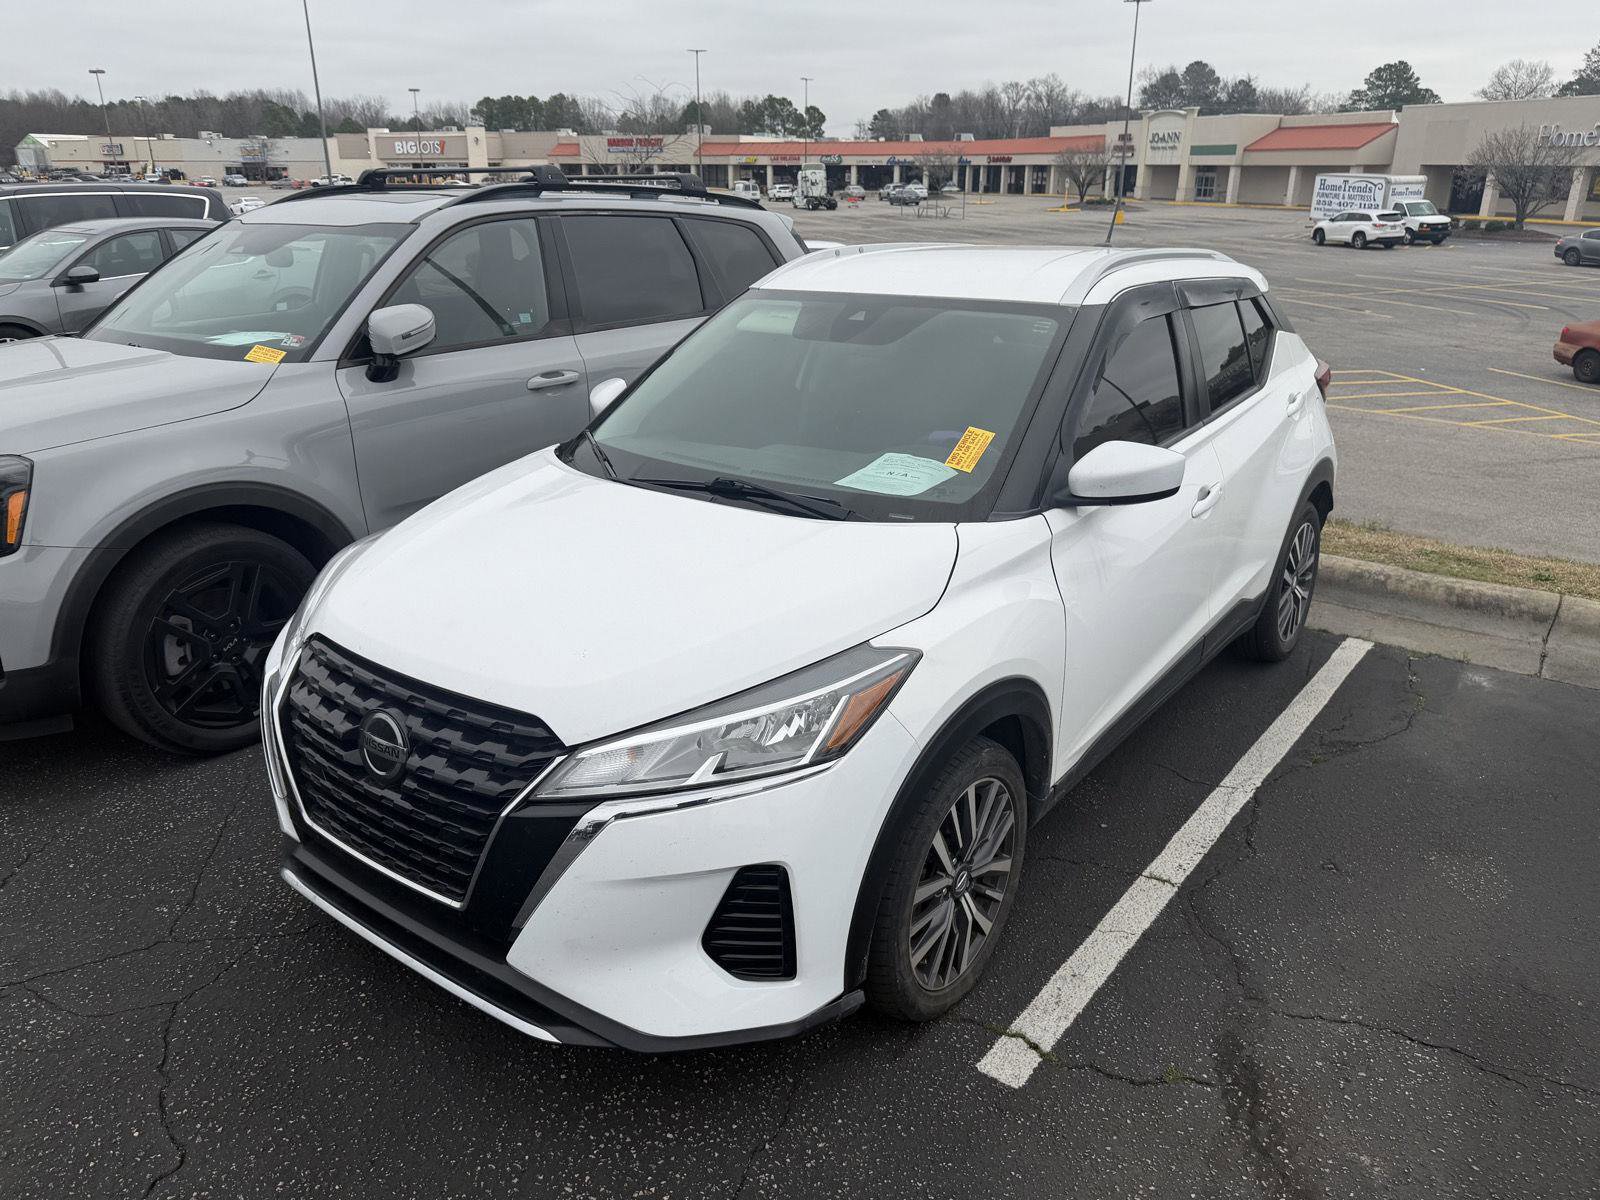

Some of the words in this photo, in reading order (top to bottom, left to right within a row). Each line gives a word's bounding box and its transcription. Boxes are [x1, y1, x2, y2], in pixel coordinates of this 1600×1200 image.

[394, 140, 417, 154] BIG
[1319, 178, 1373, 194] HomeTrends
[1391, 187, 1422, 197] HomeTrends
[1316, 192, 1341, 200] FURNITURE
[1347, 194, 1372, 202] MATTRESS
[1316, 199, 1380, 210] 252-407-1122
[947, 451, 960, 465] THIS
[956, 429, 975, 452] VEHICLE
[955, 455, 965, 466] NOT
[962, 444, 972, 456] FOR
[969, 432, 981, 445] SALE
[363, 734, 400, 759] NISSAN
